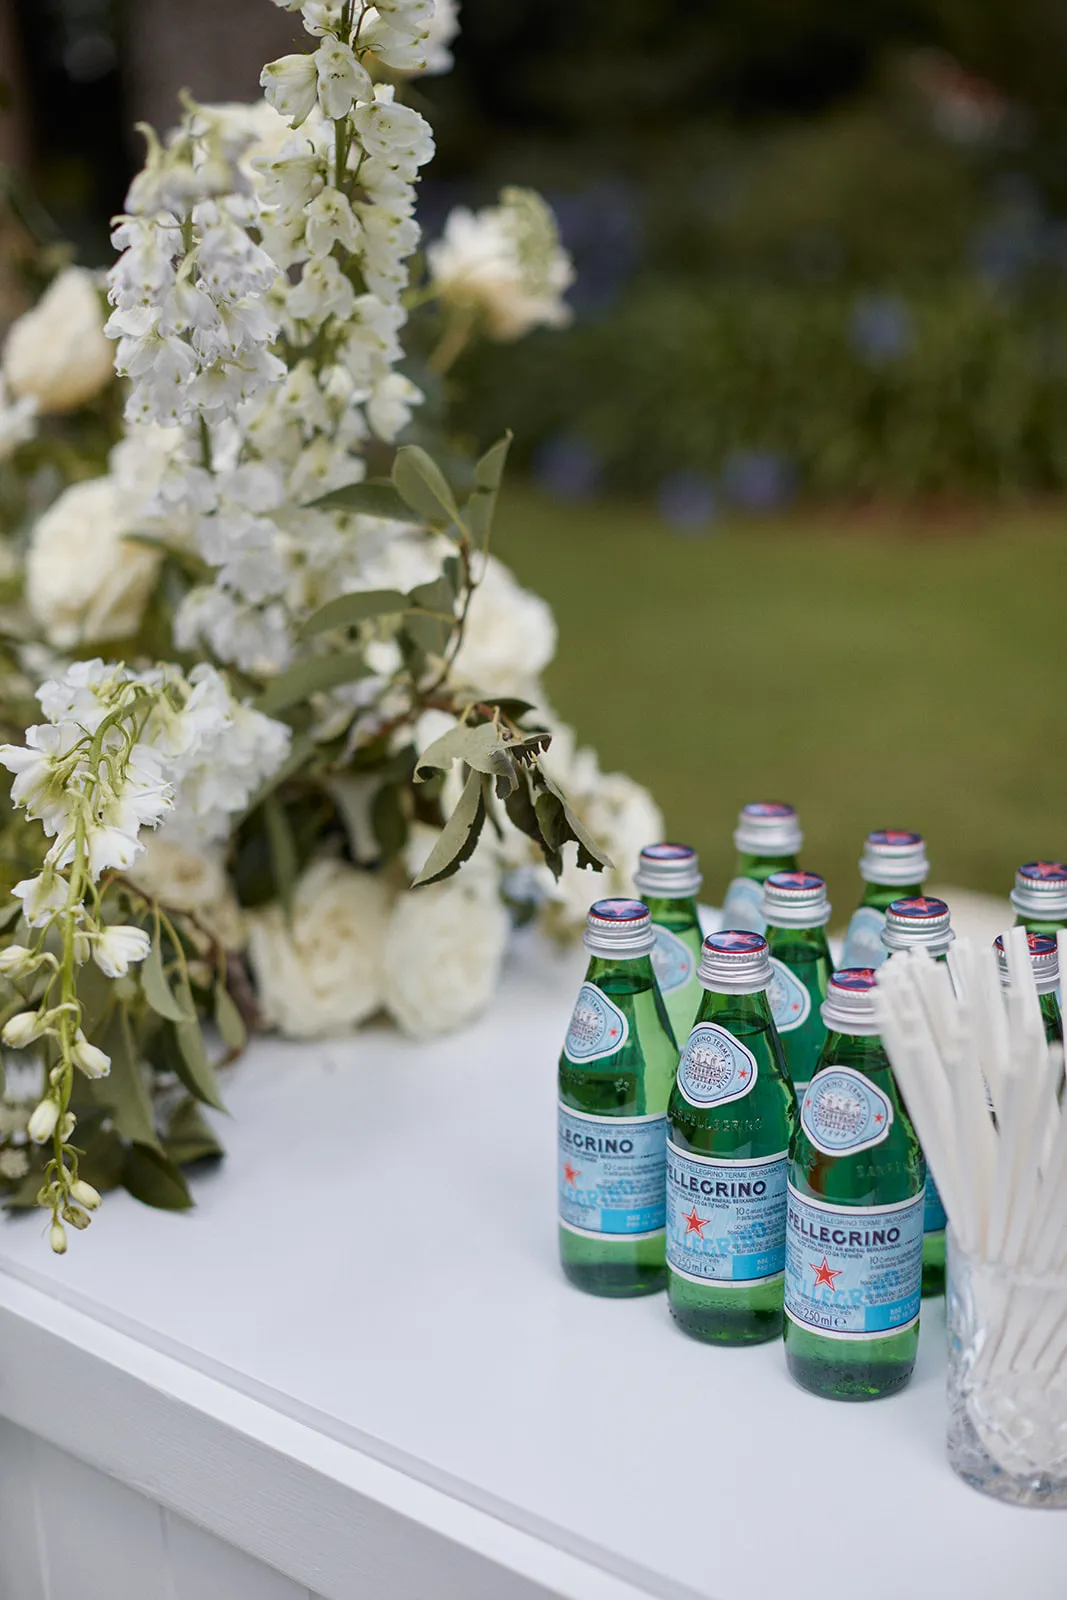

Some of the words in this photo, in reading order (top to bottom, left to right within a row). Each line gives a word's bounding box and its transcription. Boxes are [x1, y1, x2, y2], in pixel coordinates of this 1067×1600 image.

[713, 1038, 731, 1059] TERME
[716, 1068, 732, 1090] ITALIA
[725, 1170, 748, 1179] TERME
[789, 1207, 901, 1247] PELLEGRINO
[803, 1307, 821, 1323] 250
[820, 1314, 833, 1327] ml
